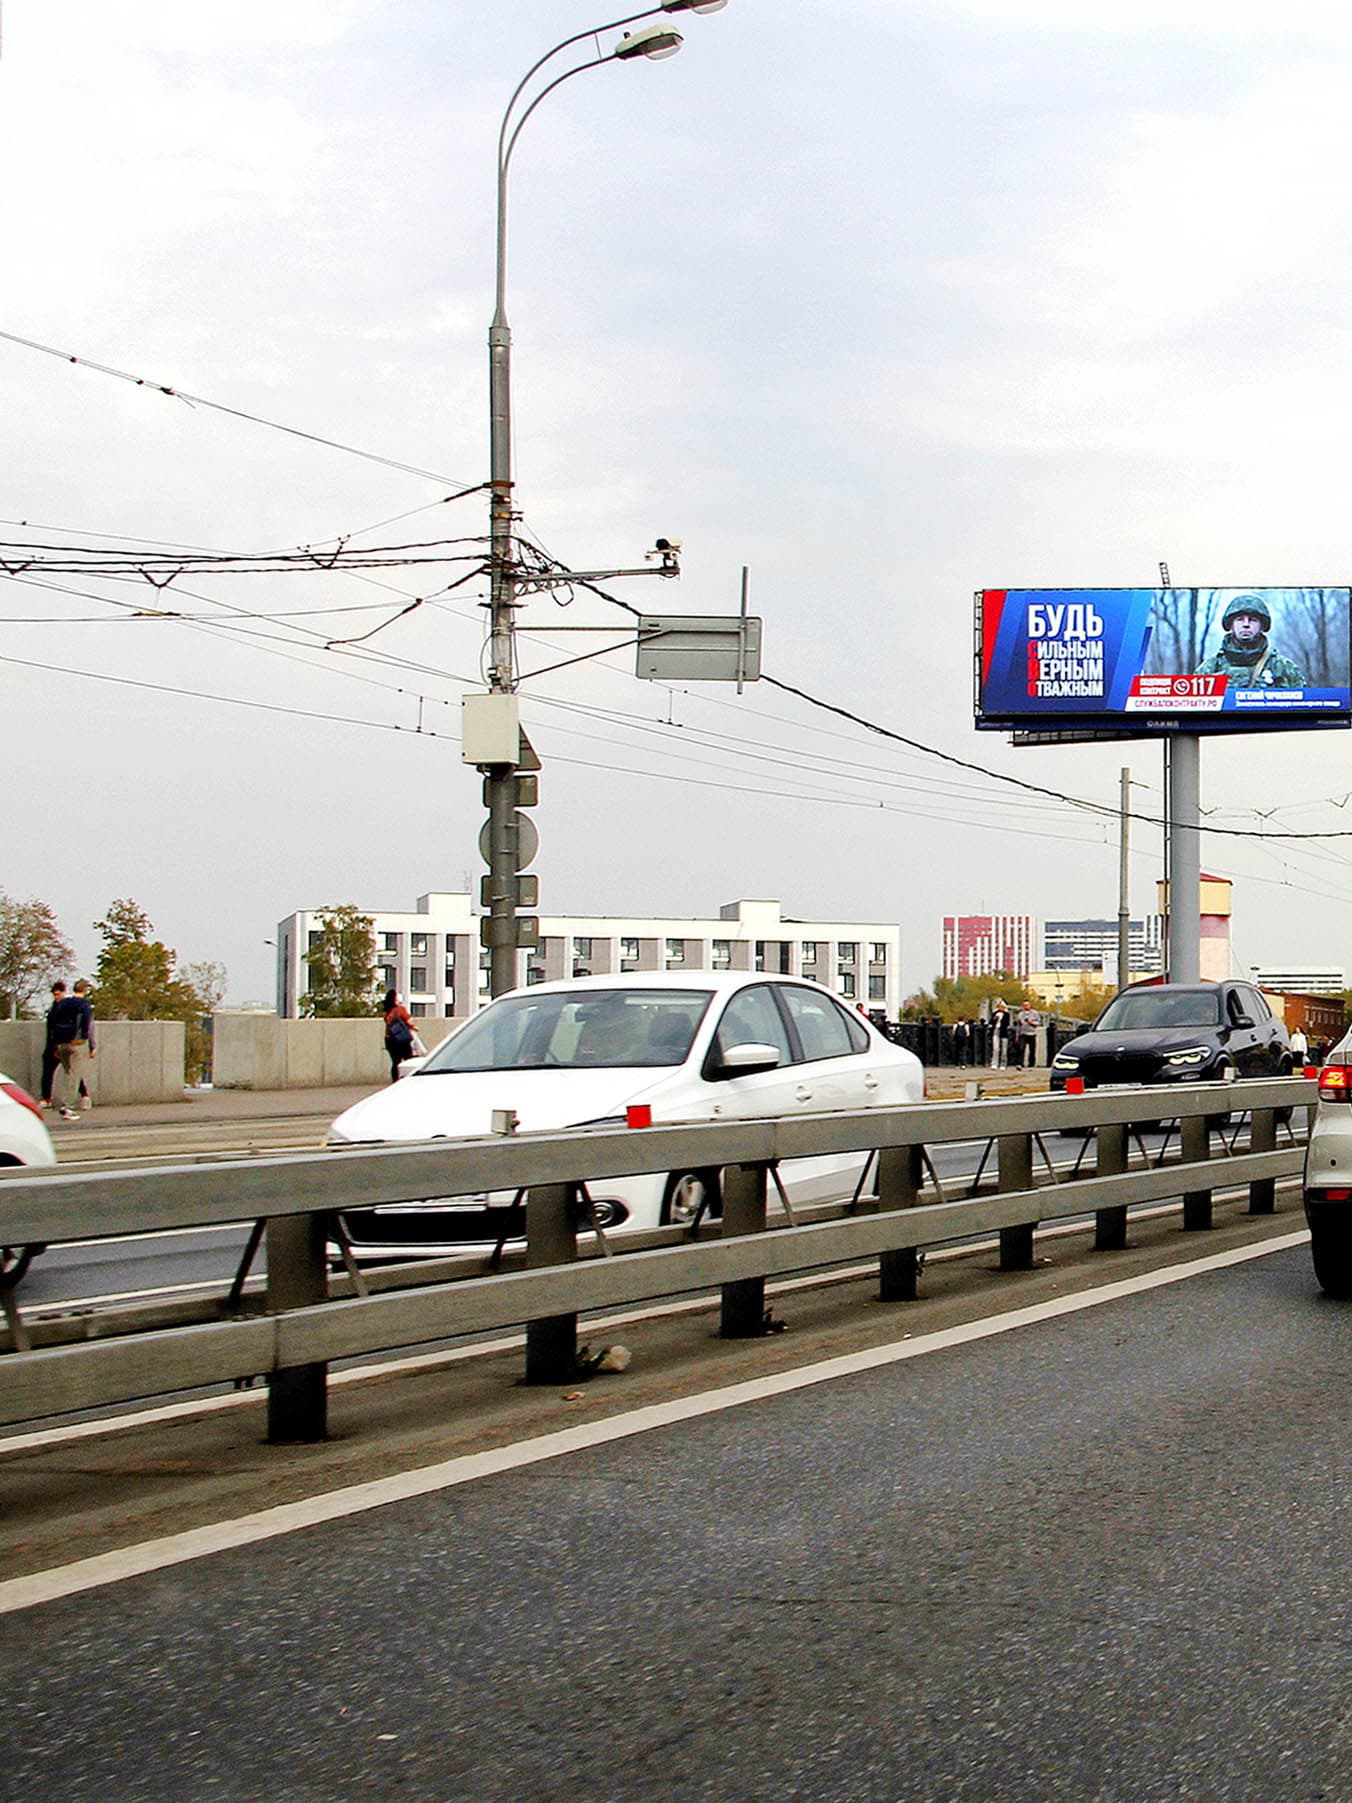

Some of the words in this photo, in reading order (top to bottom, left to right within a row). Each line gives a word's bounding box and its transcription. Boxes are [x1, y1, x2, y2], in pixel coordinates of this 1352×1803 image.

[1028, 604, 1104, 641] БУДЬ
[1027, 641, 1104, 659] СИЛЬНЫМ
[1027, 659, 1104, 681] ВЕРНЫМ
[1027, 681, 1104, 697] ОТВАЖНЫМ
[1190, 677, 1216, 695] 117
